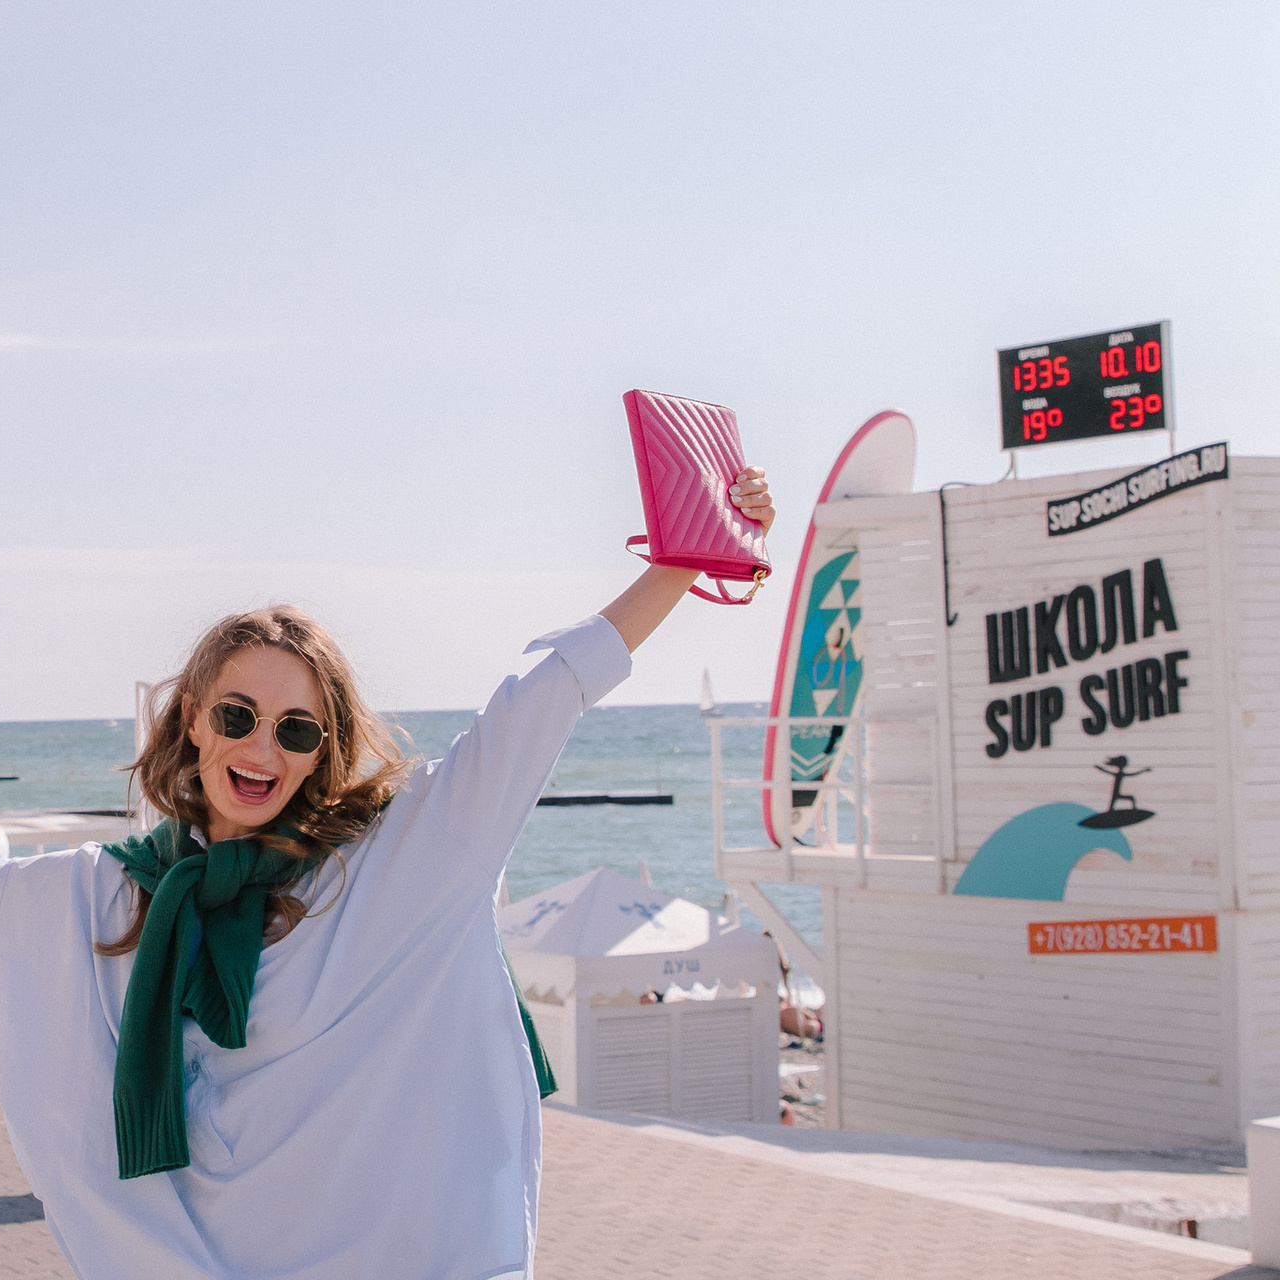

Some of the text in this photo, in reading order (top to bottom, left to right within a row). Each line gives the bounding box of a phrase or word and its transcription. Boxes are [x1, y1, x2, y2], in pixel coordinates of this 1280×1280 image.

[1048, 500, 1081, 532] SUP
[1080, 480, 1128, 523] SOCHI
[985, 558, 1178, 685] ШКОЛА
[985, 650, 1190, 759] SUP SURF
[1105, 922, 1204, 950] 852-21-41
[663, 959, 700, 974] ДУШ
